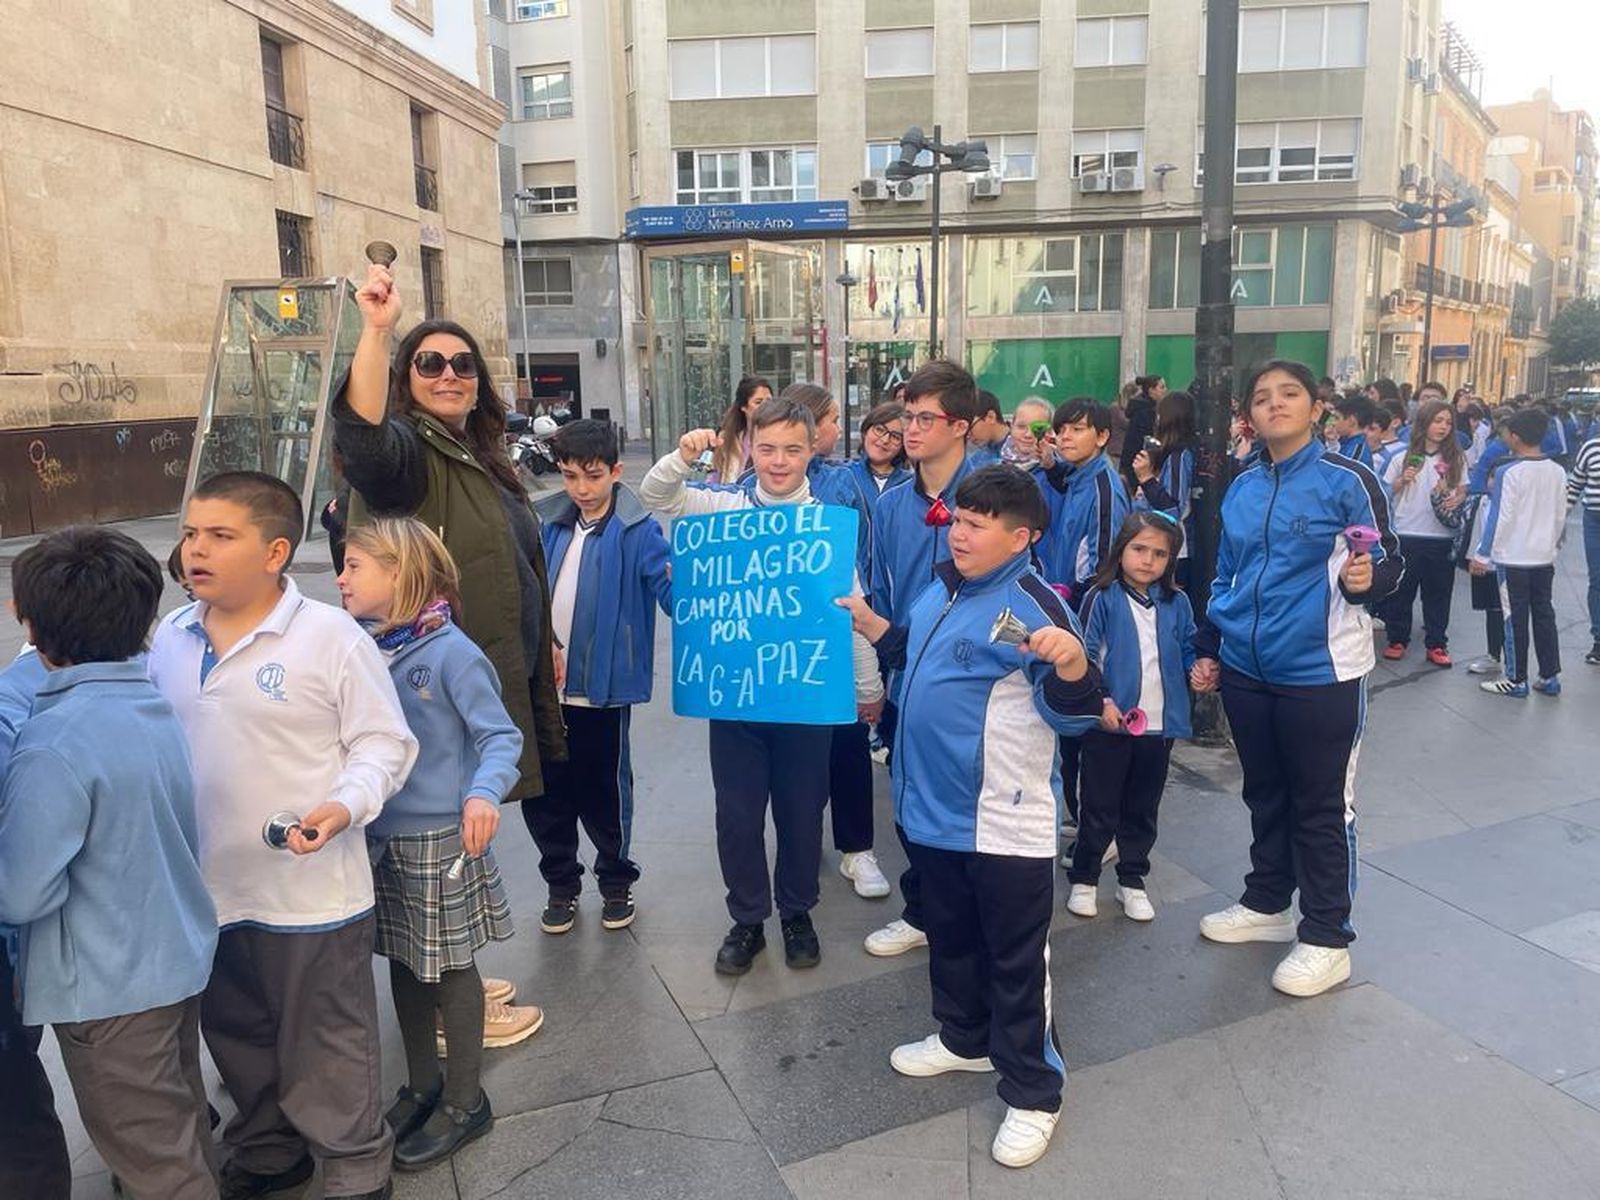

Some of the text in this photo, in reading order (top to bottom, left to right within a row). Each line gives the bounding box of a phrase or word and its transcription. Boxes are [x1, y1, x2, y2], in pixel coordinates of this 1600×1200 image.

[1034, 285, 1054, 306] A
[1230, 278, 1248, 299] A
[883, 360, 909, 391] A
[1029, 363, 1055, 388] A
[673, 503, 832, 557] COLEGIO EL
[691, 538, 833, 588] MILAGRO
[674, 584, 802, 626] CAMPANAS
[710, 618, 753, 646] POR
[676, 638, 830, 687] LA PAZ
